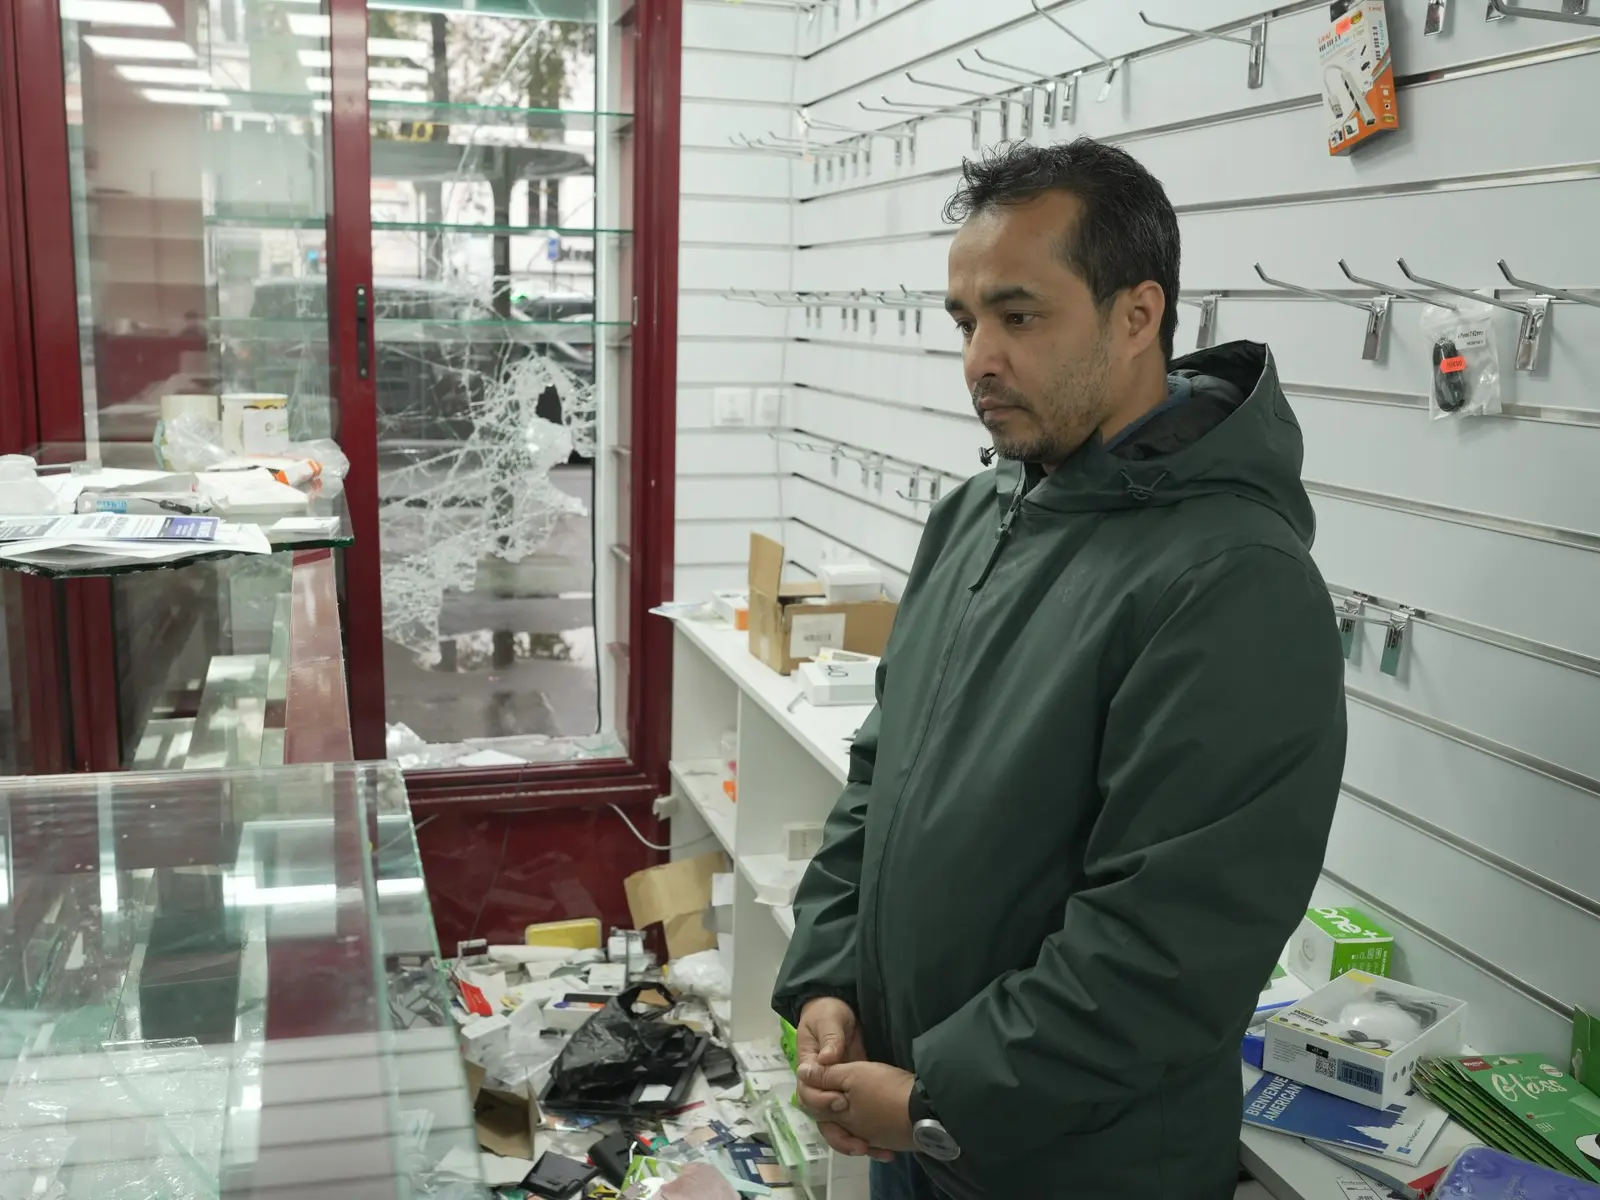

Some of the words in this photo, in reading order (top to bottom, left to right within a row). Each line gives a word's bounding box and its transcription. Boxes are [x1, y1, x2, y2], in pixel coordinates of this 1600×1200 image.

[1294, 1009, 1328, 1025] WIRELESS
[1244, 1076, 1289, 1117] BIENVENUE
[1262, 1083, 1303, 1122] AMERICAN
[1491, 1073, 1568, 1102] Glass
